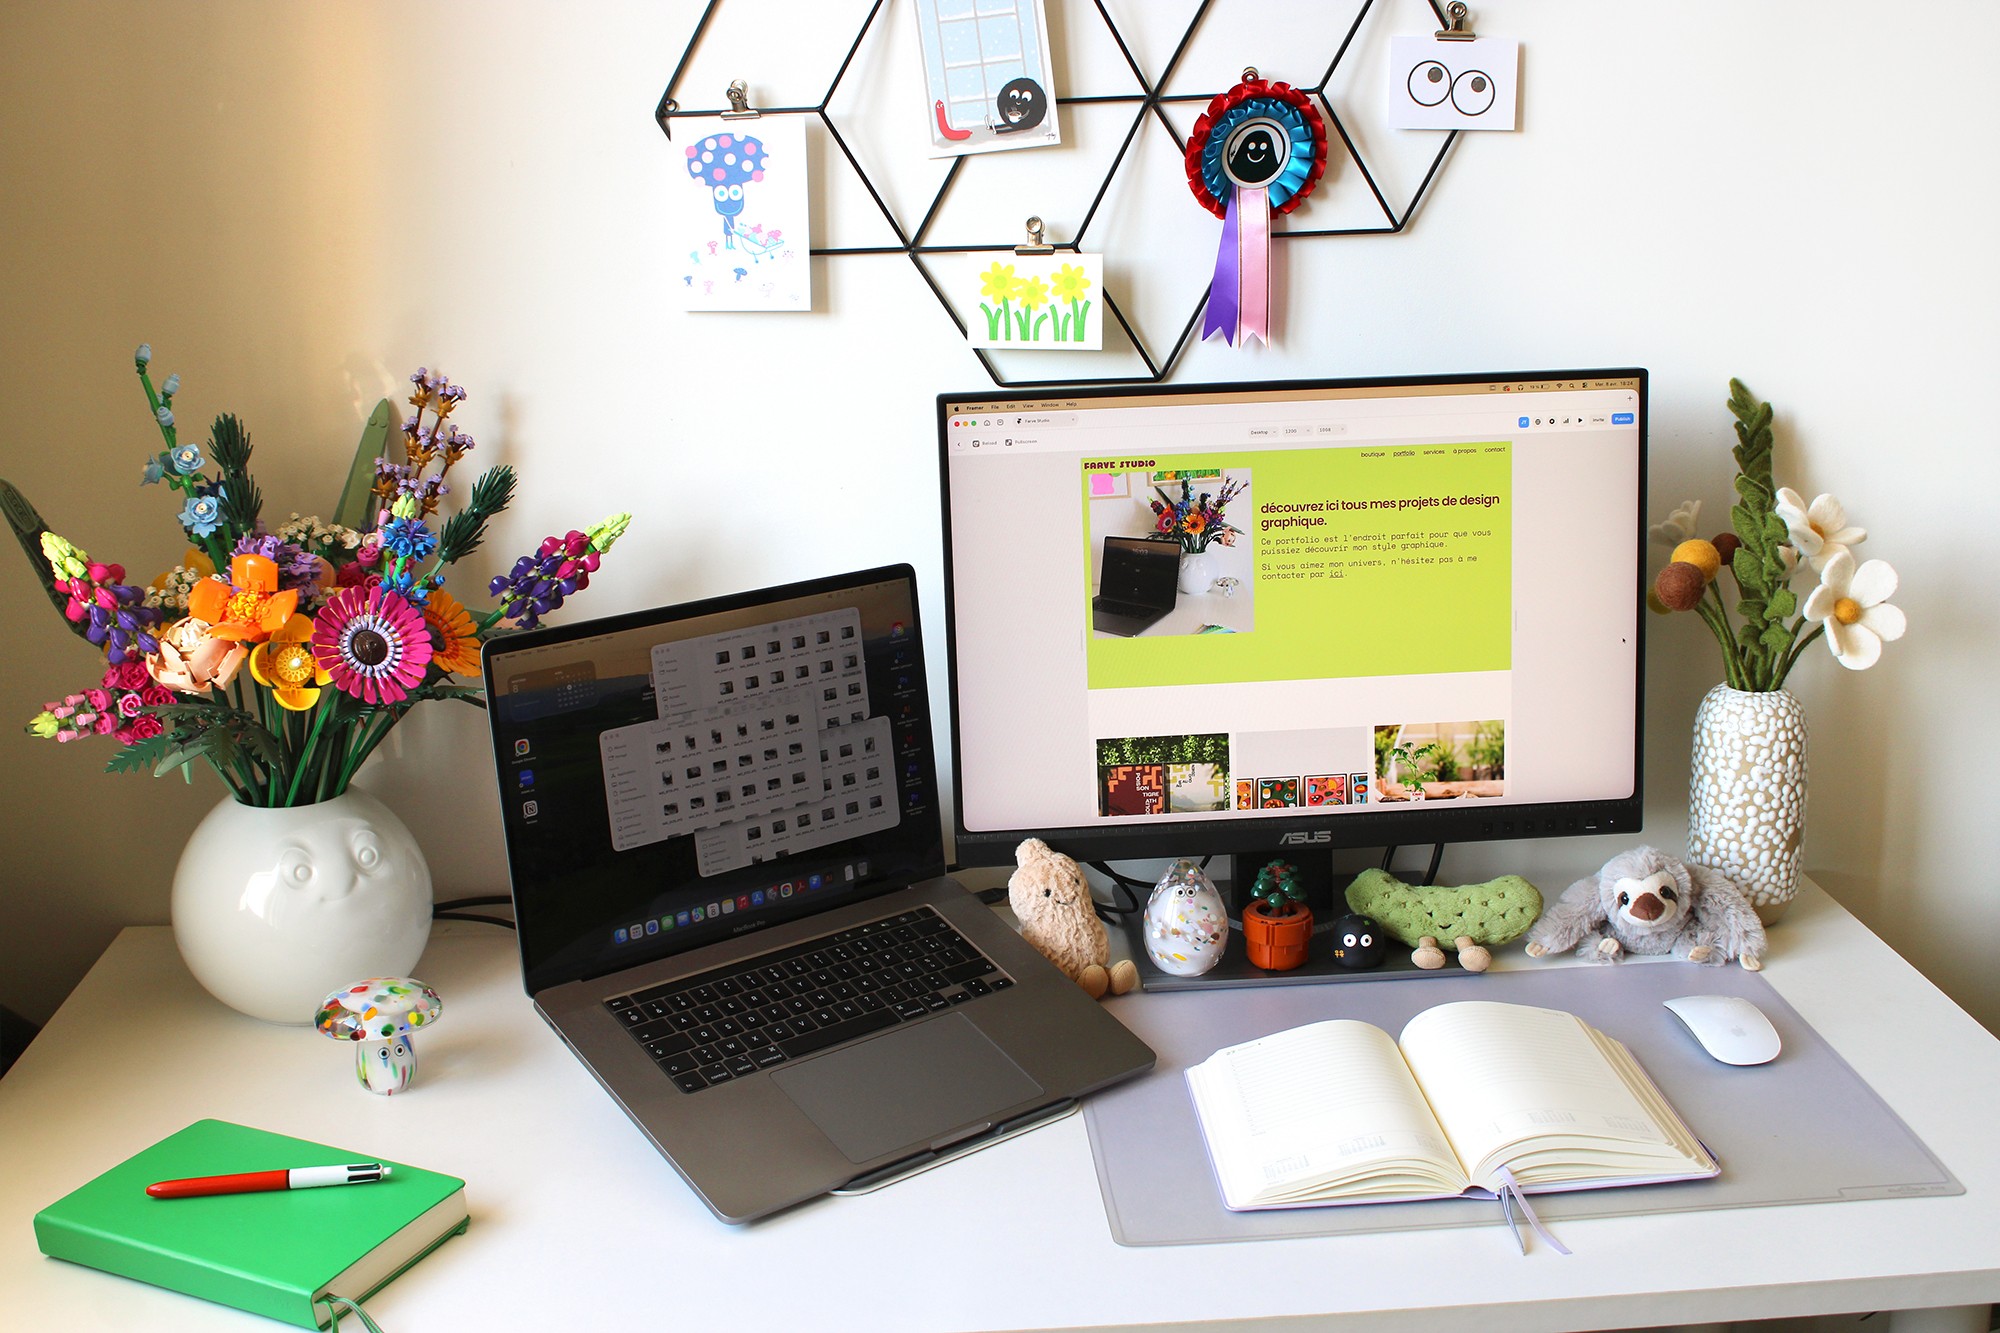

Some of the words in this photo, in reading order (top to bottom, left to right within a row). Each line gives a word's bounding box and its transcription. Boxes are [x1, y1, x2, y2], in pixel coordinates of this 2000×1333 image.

[1261, 502, 1324, 513] découvrez
[1326, 500, 1339, 510] ici
[1342, 500, 1367, 510] tous
[1370, 500, 1396, 508] mes
[1399, 496, 1439, 511] projets
[1442, 496, 1457, 506] de
[1460, 494, 1500, 507] design
[1261, 516, 1327, 531] graphique.
[1276, 536, 1319, 546] portfolio
[1344, 533, 1386, 542] l'endroit
[1391, 532, 1424, 541] parfait
[1429, 531, 1449, 539] pour
[1262, 547, 1300, 556] puissiez
[1305, 545, 1348, 553] découvrir
[1372, 543, 1396, 552] style
[1401, 542, 1448, 550] graphique.
[1329, 570, 1347, 578] ici.
[1280, 830, 1331, 844] ASUS
[711, 908, 716, 916] 8
[733, 922, 755, 933] MacBook
[760, 1054, 782, 1063] command
